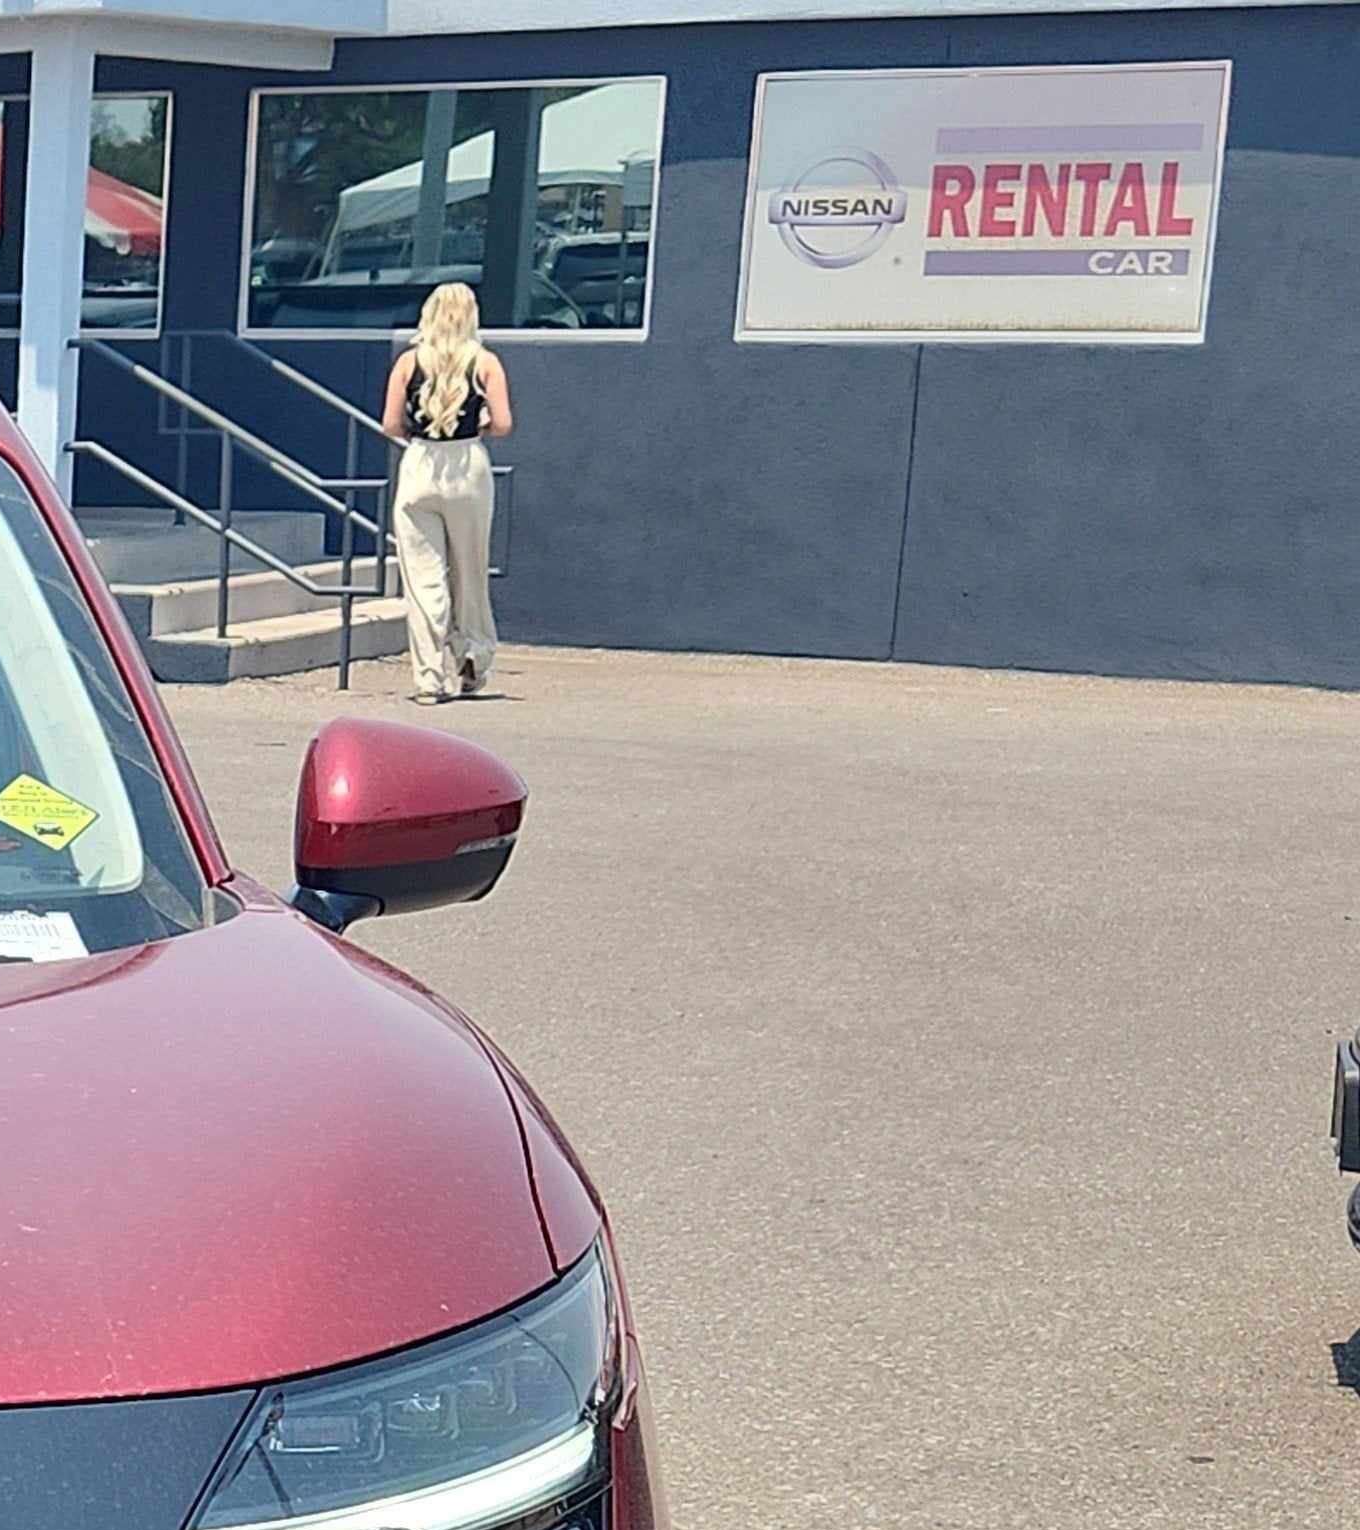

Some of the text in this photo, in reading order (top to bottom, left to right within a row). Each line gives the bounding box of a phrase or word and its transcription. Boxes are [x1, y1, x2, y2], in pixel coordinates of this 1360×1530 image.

[781, 198, 894, 217] NISSAN
[926, 161, 1194, 239] RENTAL
[1087, 250, 1175, 275] CAR
